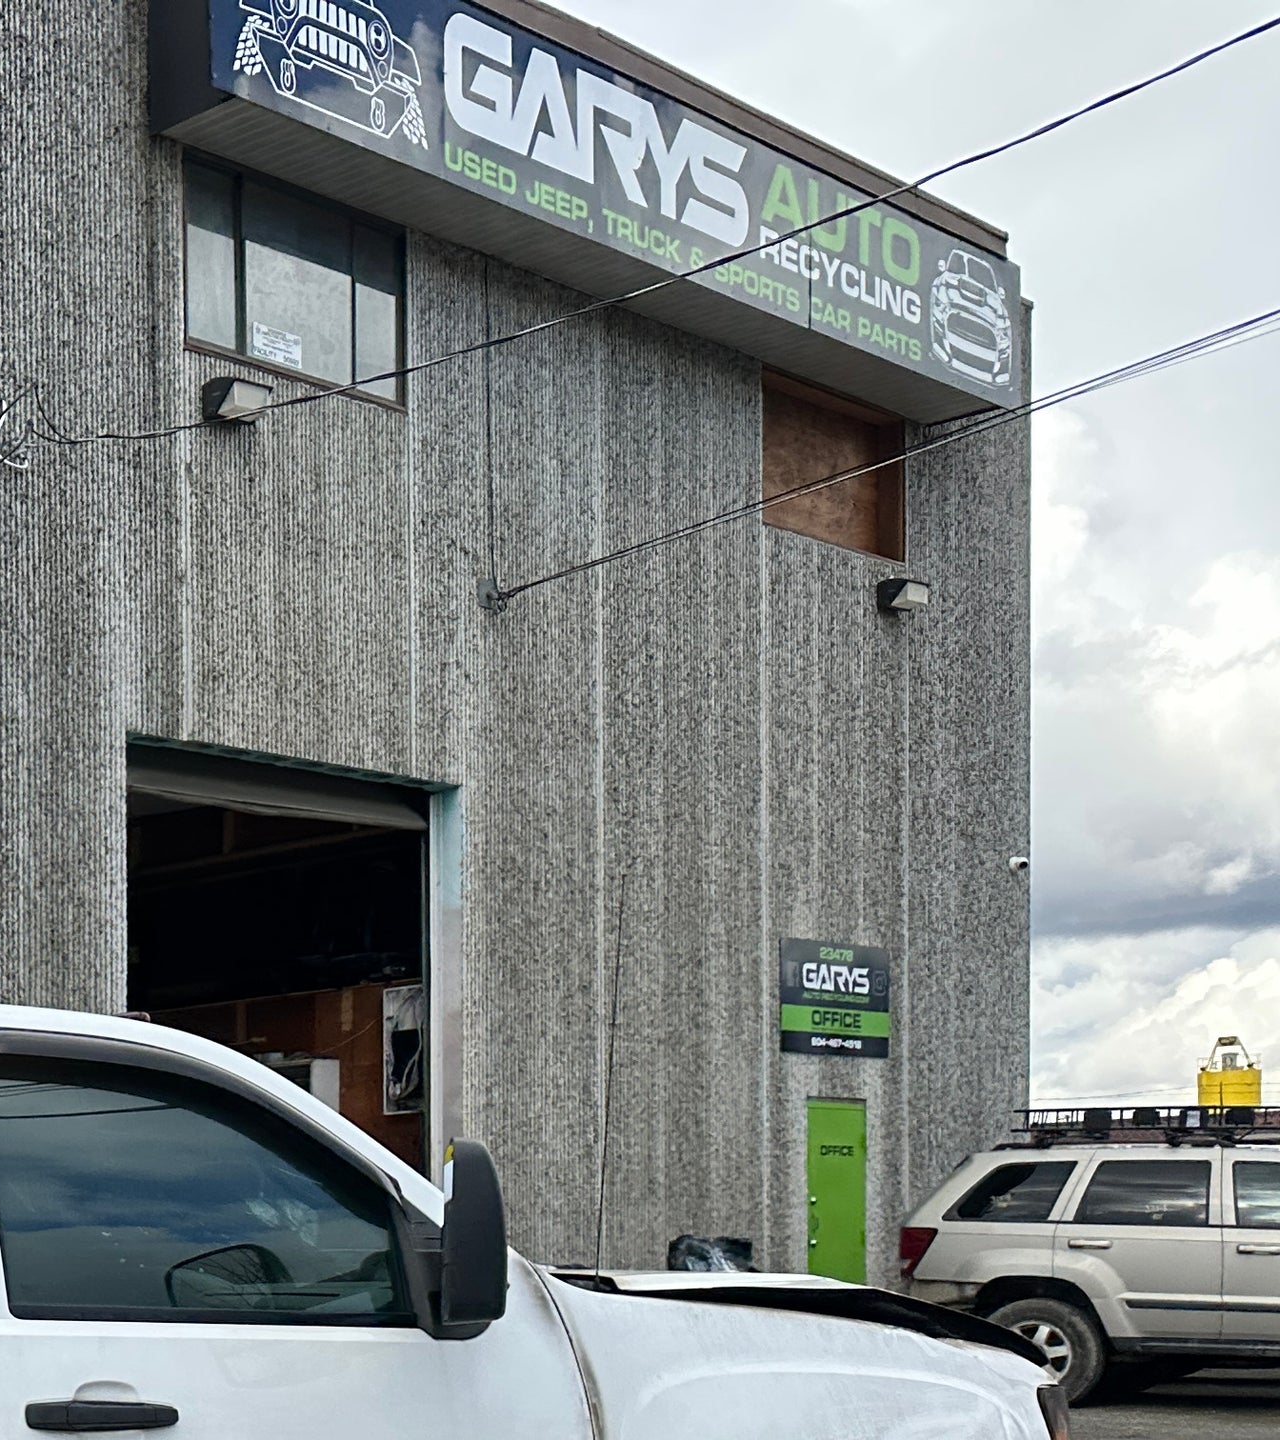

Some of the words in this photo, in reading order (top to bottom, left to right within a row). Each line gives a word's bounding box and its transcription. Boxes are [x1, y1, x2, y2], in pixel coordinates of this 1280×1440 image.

[442, 10, 749, 248] GARYS
[444, 141, 517, 195] USED
[525, 181, 594, 234] JEEP,
[602, 208, 683, 264] TRUCK
[690, 246, 705, 270] &
[714, 262, 801, 313] SPORTS
[810, 296, 851, 334] CAR
[858, 316, 922, 361] PARTS
[761, 163, 921, 286] AUTO
[759, 225, 922, 325] RECYCLING
[802, 962, 870, 994] GARYS
[811, 1010, 862, 1029] OFFICE
[820, 1144, 854, 1157] OFFICE
